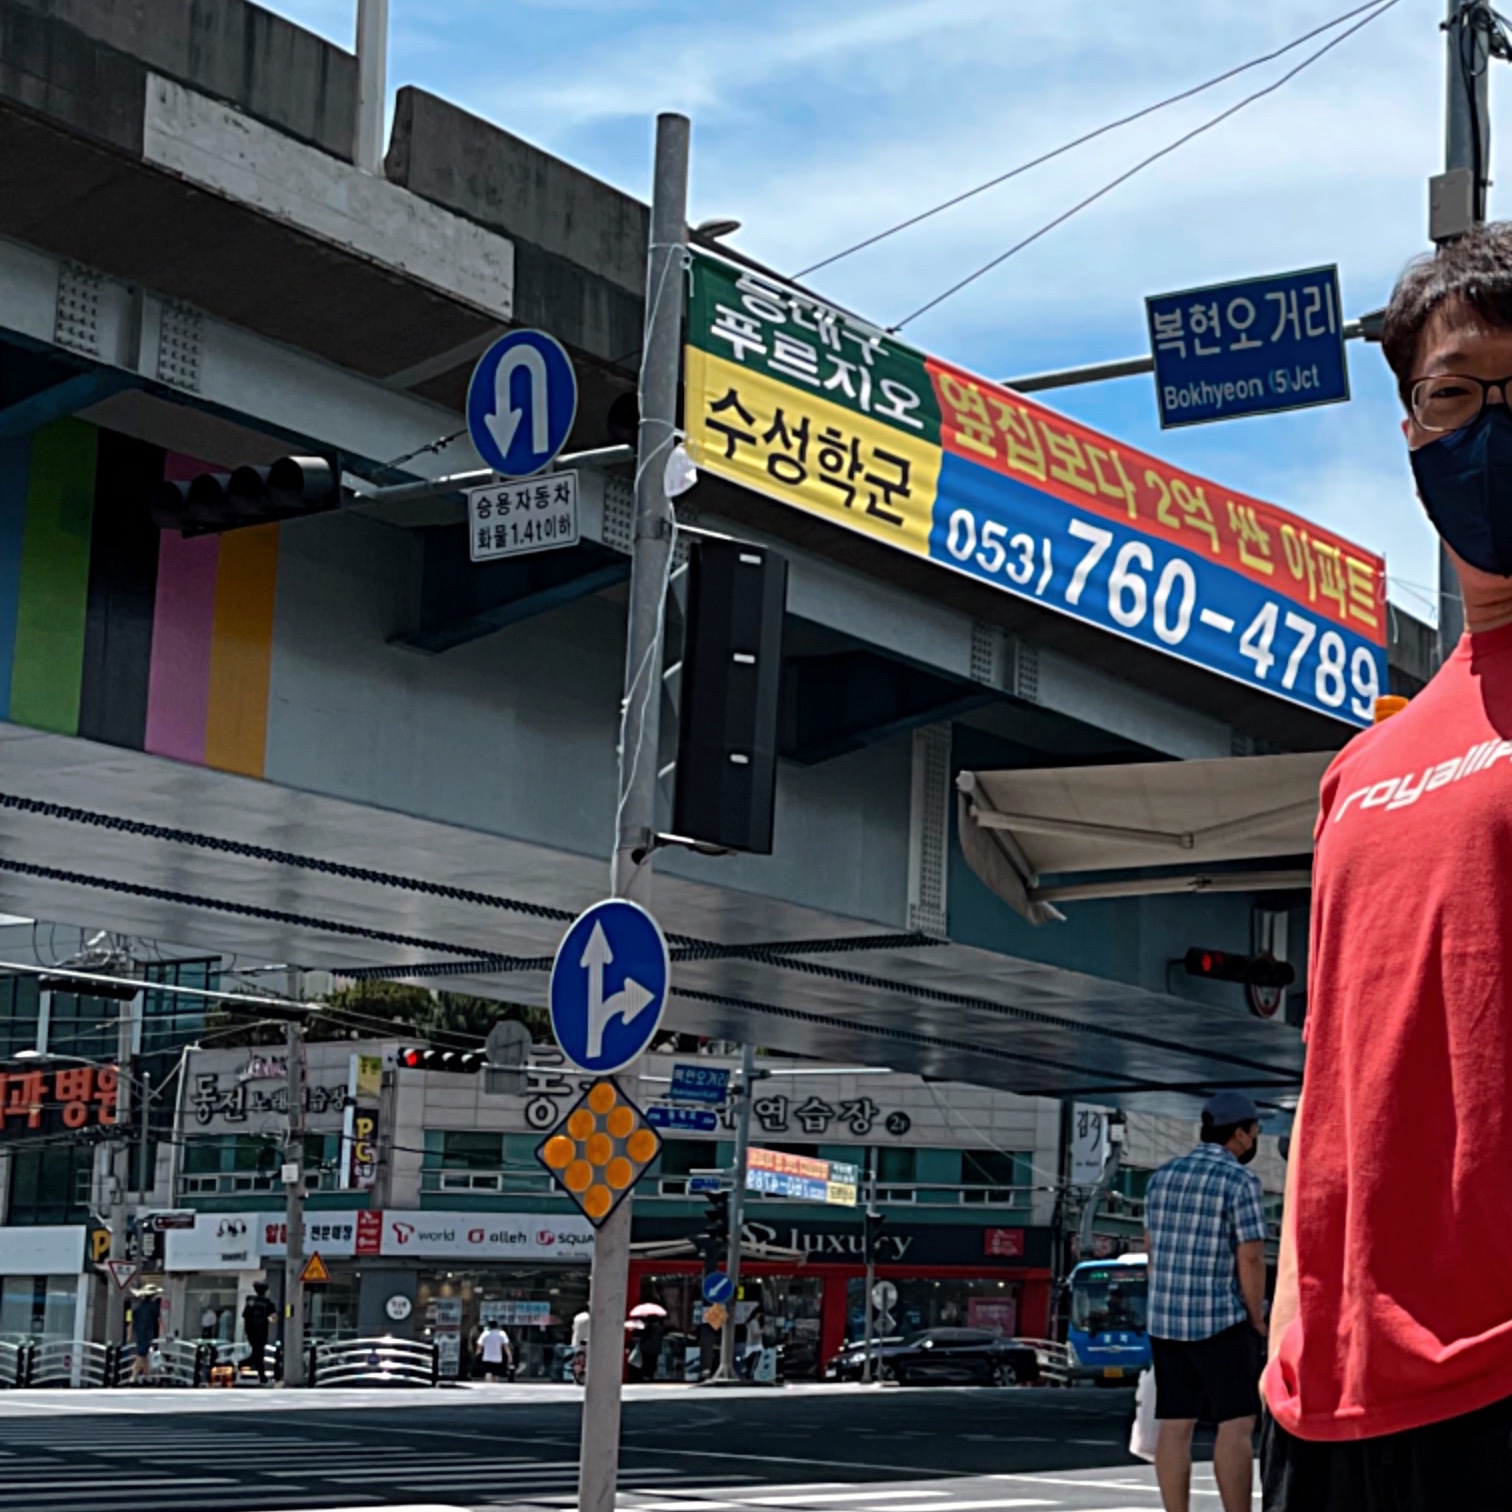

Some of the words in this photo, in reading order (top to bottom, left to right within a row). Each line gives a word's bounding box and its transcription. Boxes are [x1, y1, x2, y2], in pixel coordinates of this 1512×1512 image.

[1154, 283, 1336, 359] 복현오거리
[711, 303, 924, 430] 푸르지오
[1164, 378, 1264, 410] Bokhyeon
[705, 387, 912, 527] 수성학군
[476, 481, 571, 519] 승용자동차
[939, 373, 1137, 519] 옆집보다
[1147, 472, 1221, 556] 2억
[1227, 498, 1275, 576] 싼
[1280, 522, 1379, 628] 아파트
[191, 1074, 247, 1125] 동전
[252, 1084, 348, 1114] 노래습장
[719, 1096, 879, 1135] 연습장
[418, 1229, 455, 1242] world
[557, 1233, 595, 1246] SQUA
